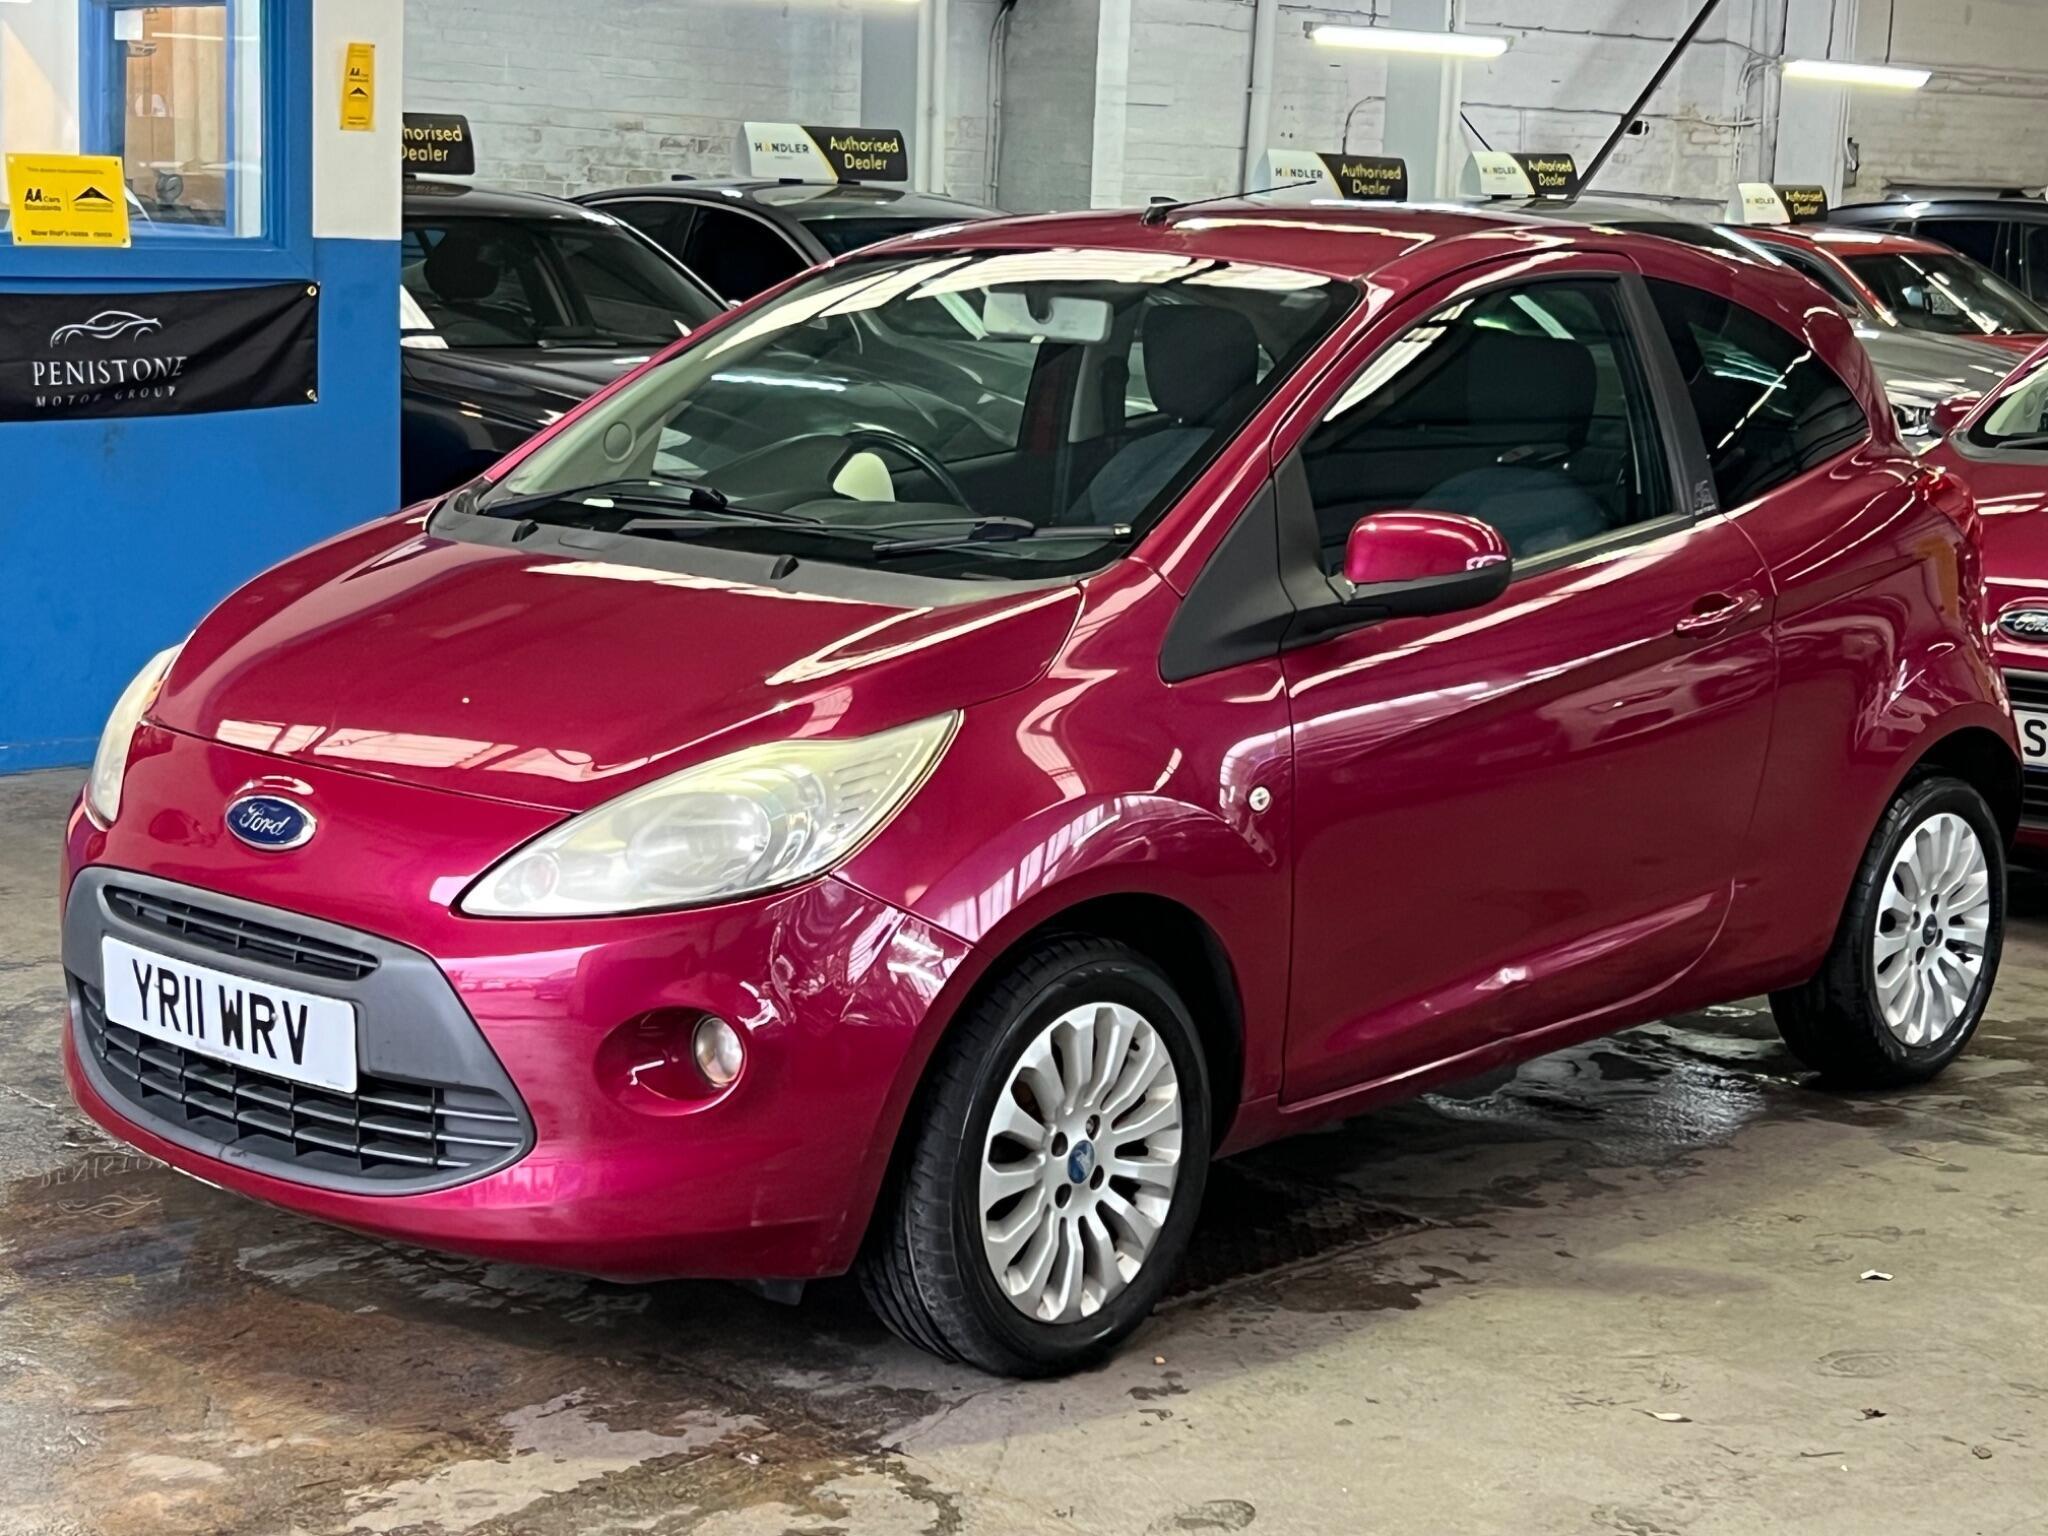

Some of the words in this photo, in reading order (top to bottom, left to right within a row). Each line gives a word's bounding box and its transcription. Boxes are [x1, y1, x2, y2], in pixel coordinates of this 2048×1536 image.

[402, 123, 463, 141] horised
[830, 136, 899, 153] Authorised
[844, 153, 888, 170] Dealer
[1341, 163, 1402, 180] Authorised
[1353, 179, 1391, 195] Dealer
[32, 356, 188, 386] PENISTONE
[2023, 719, 2047, 757] S
[239, 801, 291, 836] Ford
[132, 958, 205, 1039] YR11
[218, 984, 309, 1066] WRV
